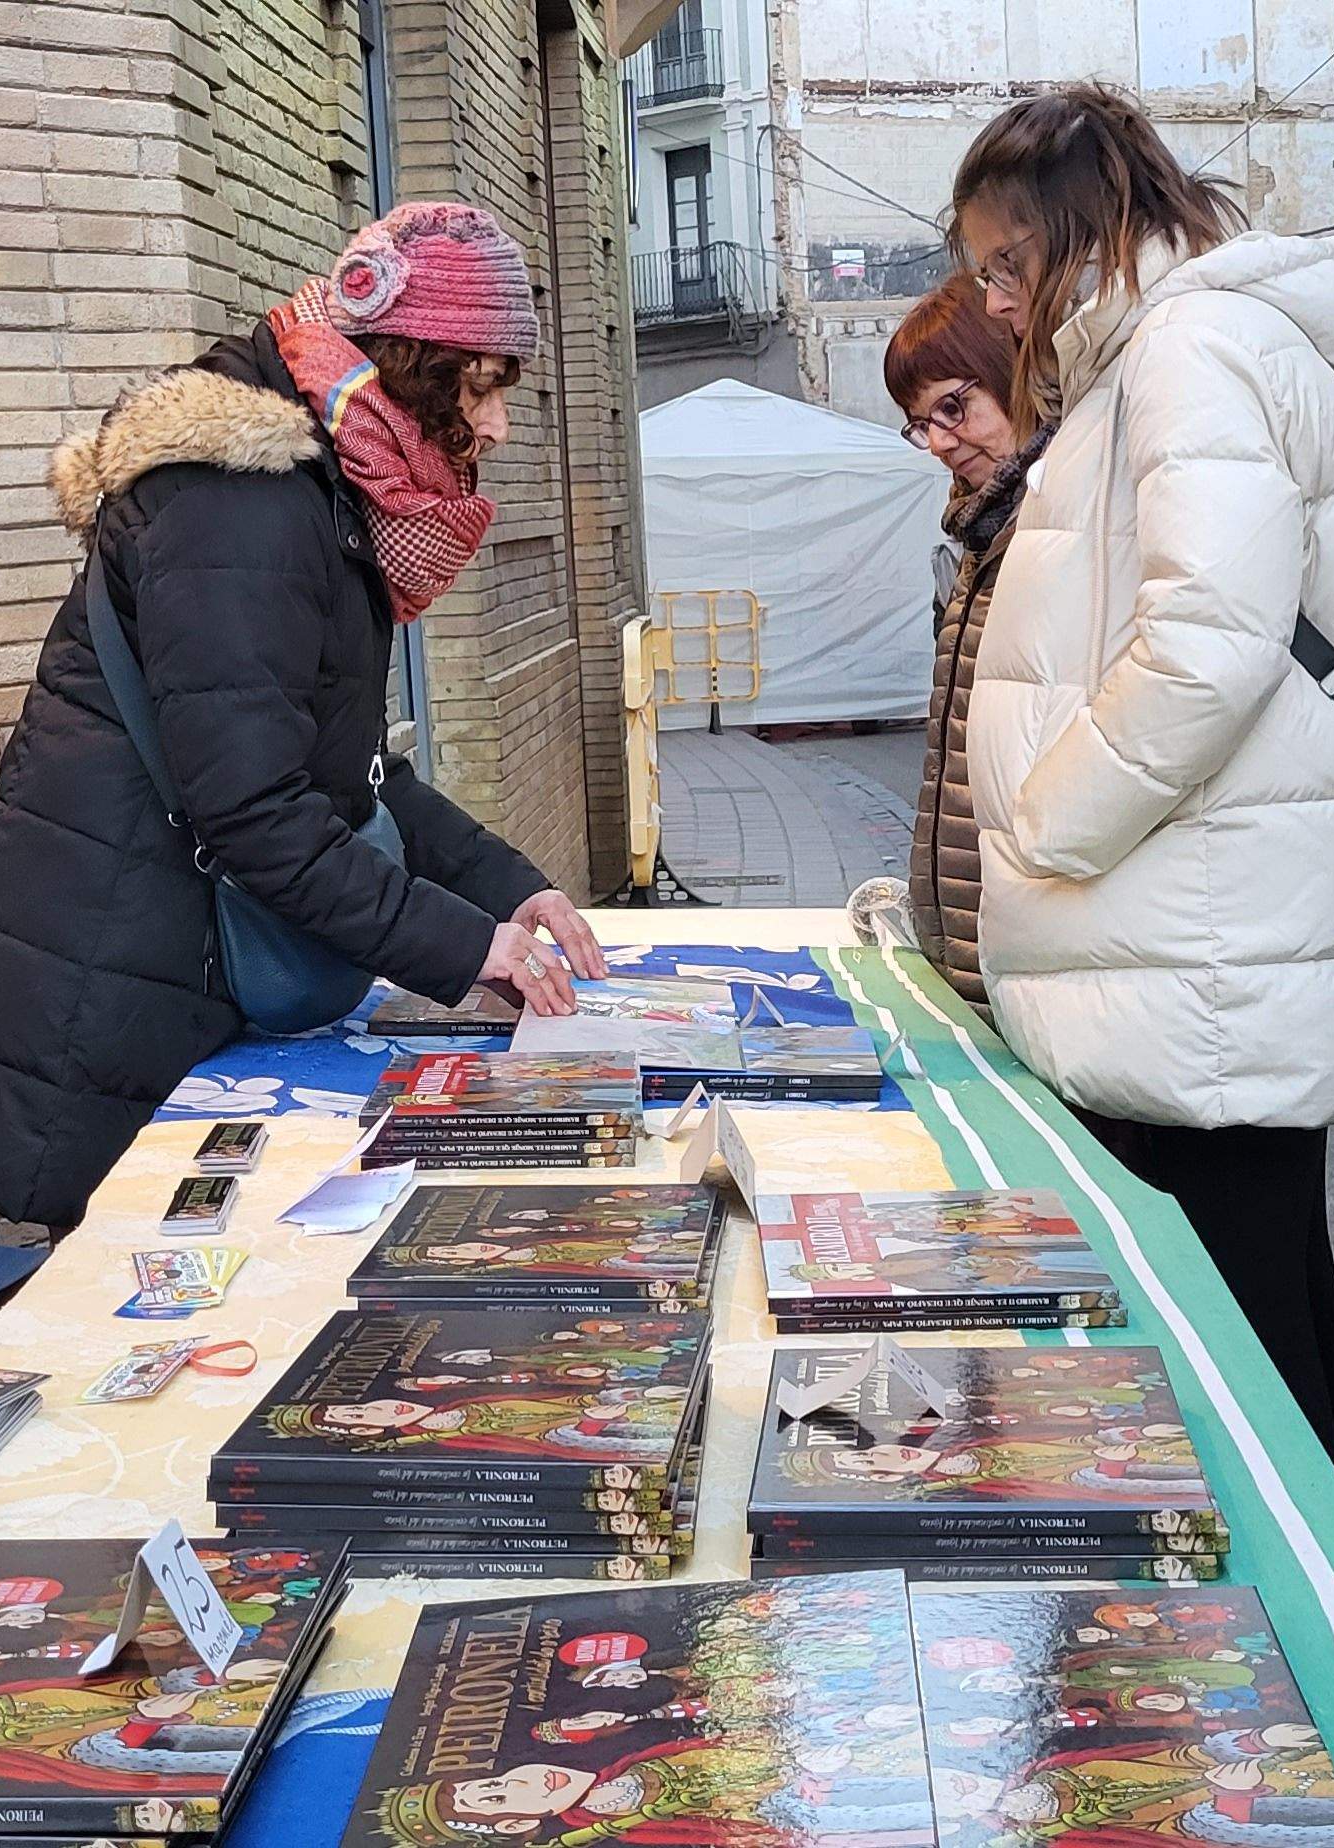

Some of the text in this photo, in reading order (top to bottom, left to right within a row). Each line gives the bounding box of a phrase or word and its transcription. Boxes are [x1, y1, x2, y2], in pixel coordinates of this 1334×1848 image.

[805, 1216, 851, 1263] RAMIRO II
[550, 1286, 600, 1294] PETRONILA
[967, 1299, 995, 1307] MONJE
[1019, 1298, 1049, 1306] RAMIRO
[560, 1305, 611, 1313] PETRONILA
[906, 1319, 914, 1327] AL
[954, 1318, 972, 1326] QUE
[309, 1314, 419, 1400] PETRONILA
[475, 1470, 540, 1481] PETRONILA
[469, 1493, 534, 1503] PETRONILA
[481, 1518, 546, 1527] PETRONILA
[1019, 1518, 1085, 1527] PETRONILA
[504, 1539, 568, 1548] PETRONILA
[1035, 1537, 1101, 1546] PETRONILA
[479, 1563, 543, 1573] PETRONILA
[1021, 1565, 1088, 1574] PETRONILA
[161, 1537, 210, 1635] 25
[426, 1604, 533, 1775] PEIRONELA
